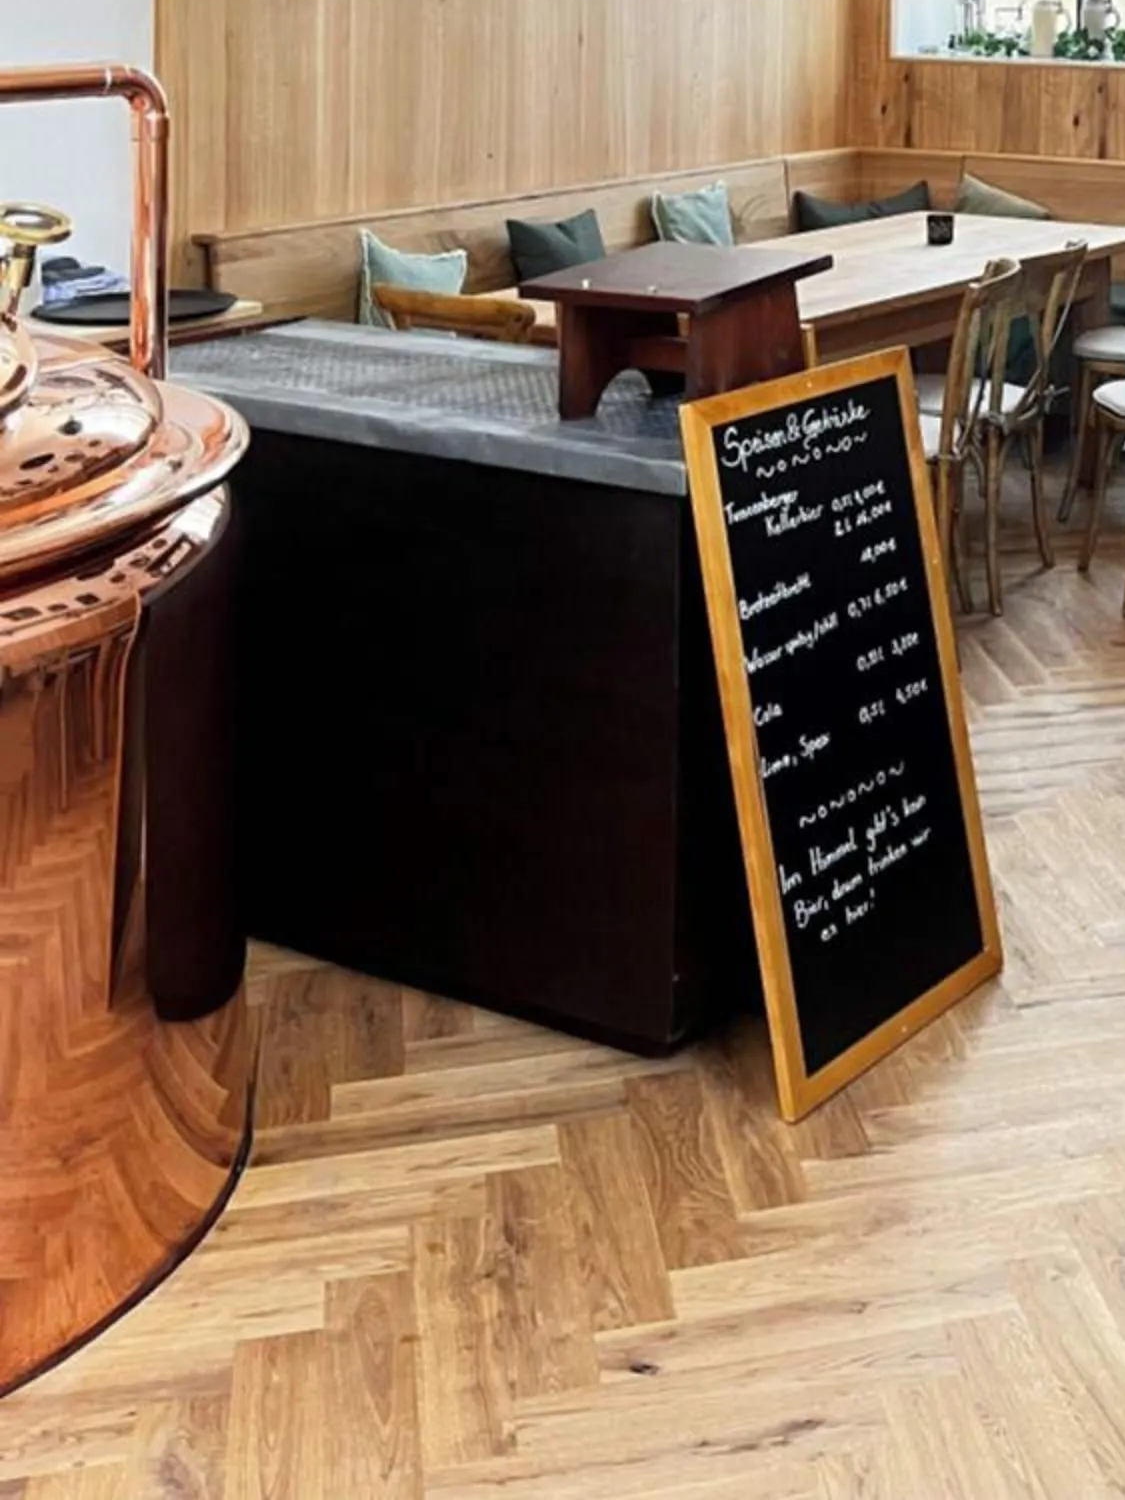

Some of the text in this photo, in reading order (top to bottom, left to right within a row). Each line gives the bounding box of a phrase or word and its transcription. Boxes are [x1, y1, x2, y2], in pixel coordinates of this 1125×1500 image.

[754, 703, 783, 727] Cola
[779, 863, 802, 895] Im
[808, 826, 858, 876] Himmel
[820, 923, 838, 942] es
